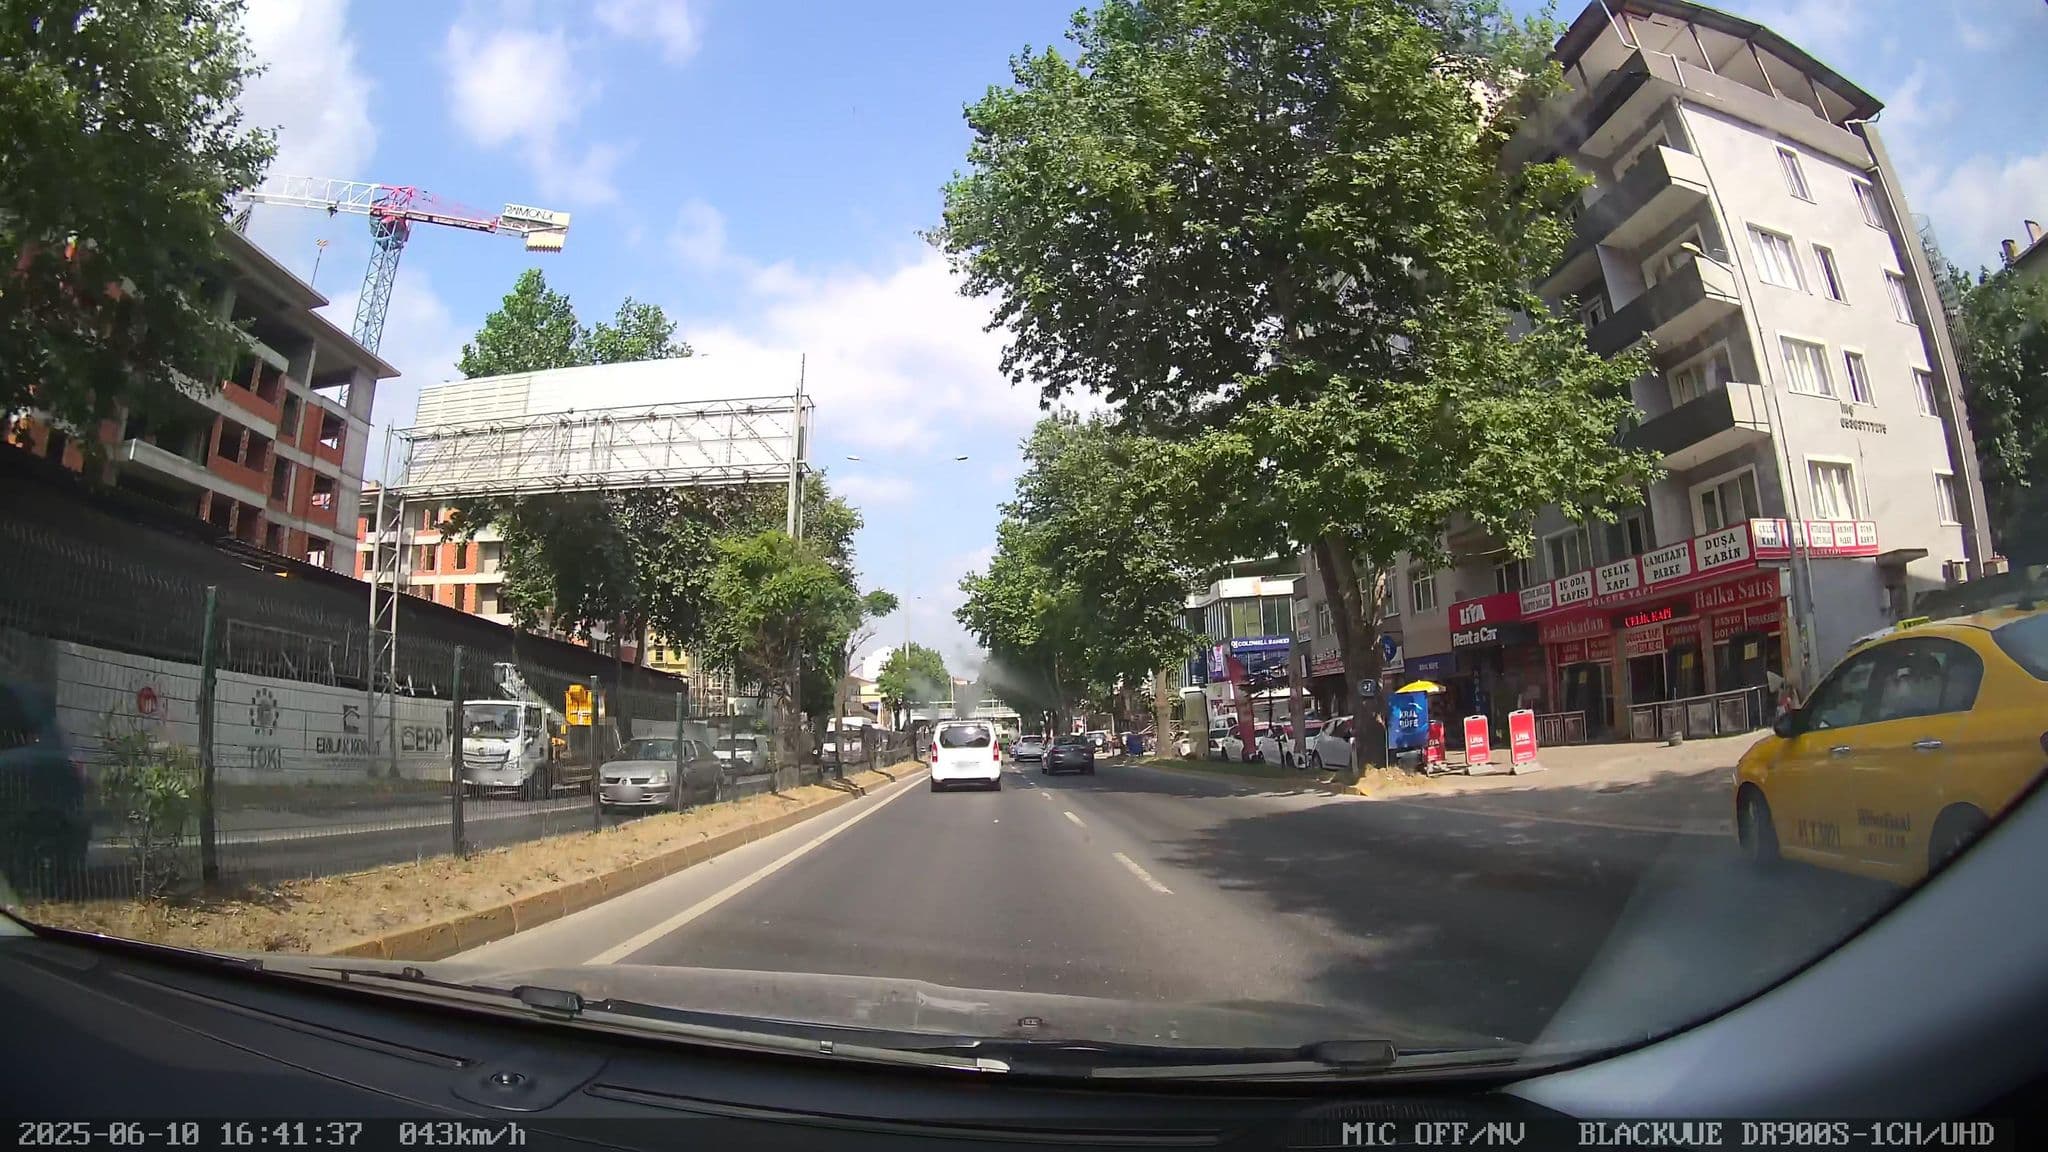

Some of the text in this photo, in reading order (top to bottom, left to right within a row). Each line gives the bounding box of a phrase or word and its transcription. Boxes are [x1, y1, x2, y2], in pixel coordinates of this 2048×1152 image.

[1705, 533, 1736, 550] DUŞA
[1704, 547, 1741, 567] KABİN
[1653, 564, 1681, 580] PARKE
[1570, 576, 1586, 588] ODA
[1606, 578, 1629, 591] KAPI
[1695, 581, 1774, 609] Halka Satış
[1453, 626, 1498, 648] Rent a Car
